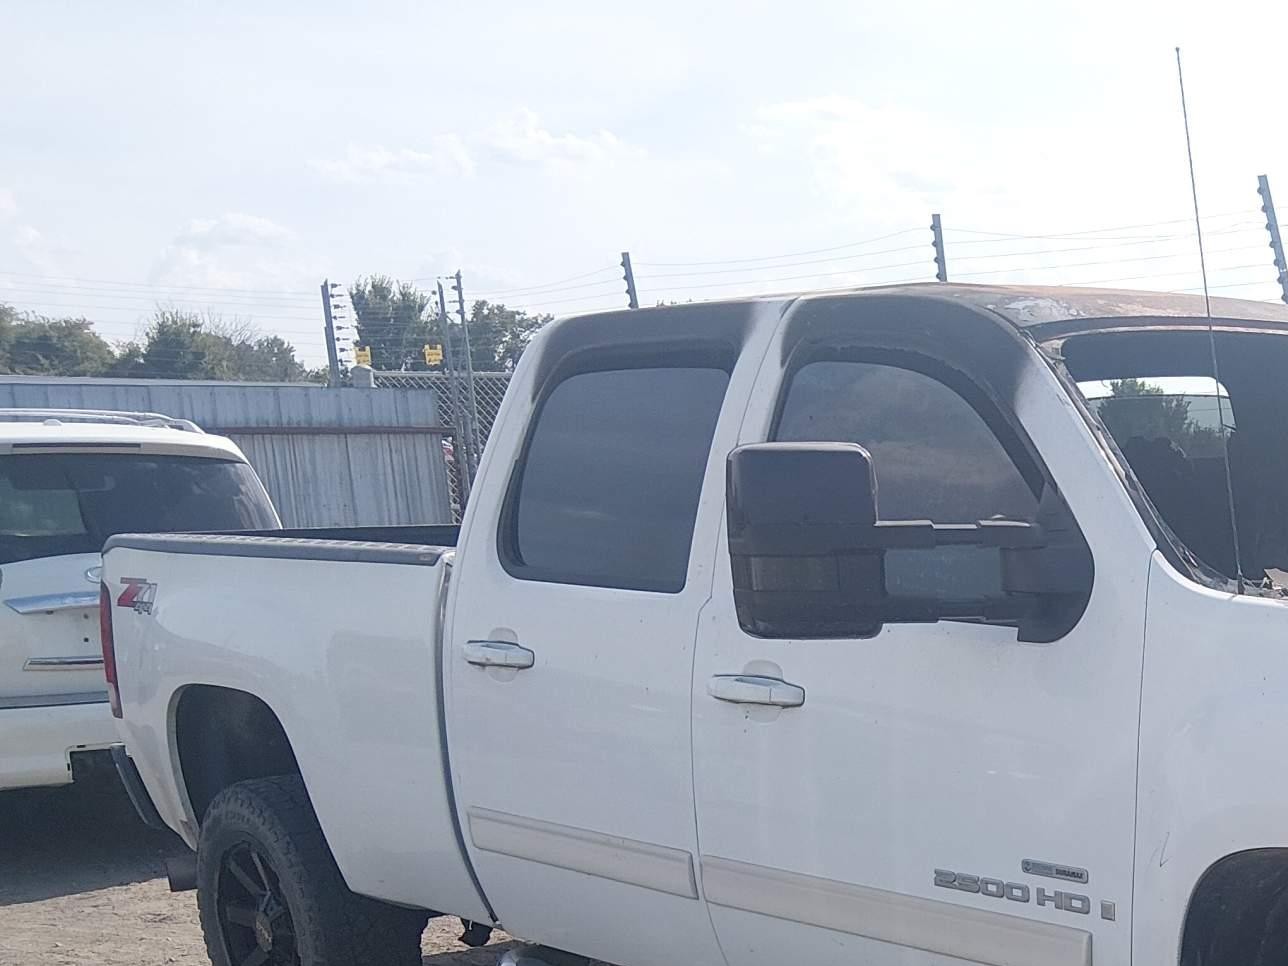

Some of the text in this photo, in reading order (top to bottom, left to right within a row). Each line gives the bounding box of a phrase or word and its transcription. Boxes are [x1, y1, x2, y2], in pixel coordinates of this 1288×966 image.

[117, 576, 158, 608] Z71
[934, 868, 1030, 903] 2500
[1036, 887, 1091, 915] HD
